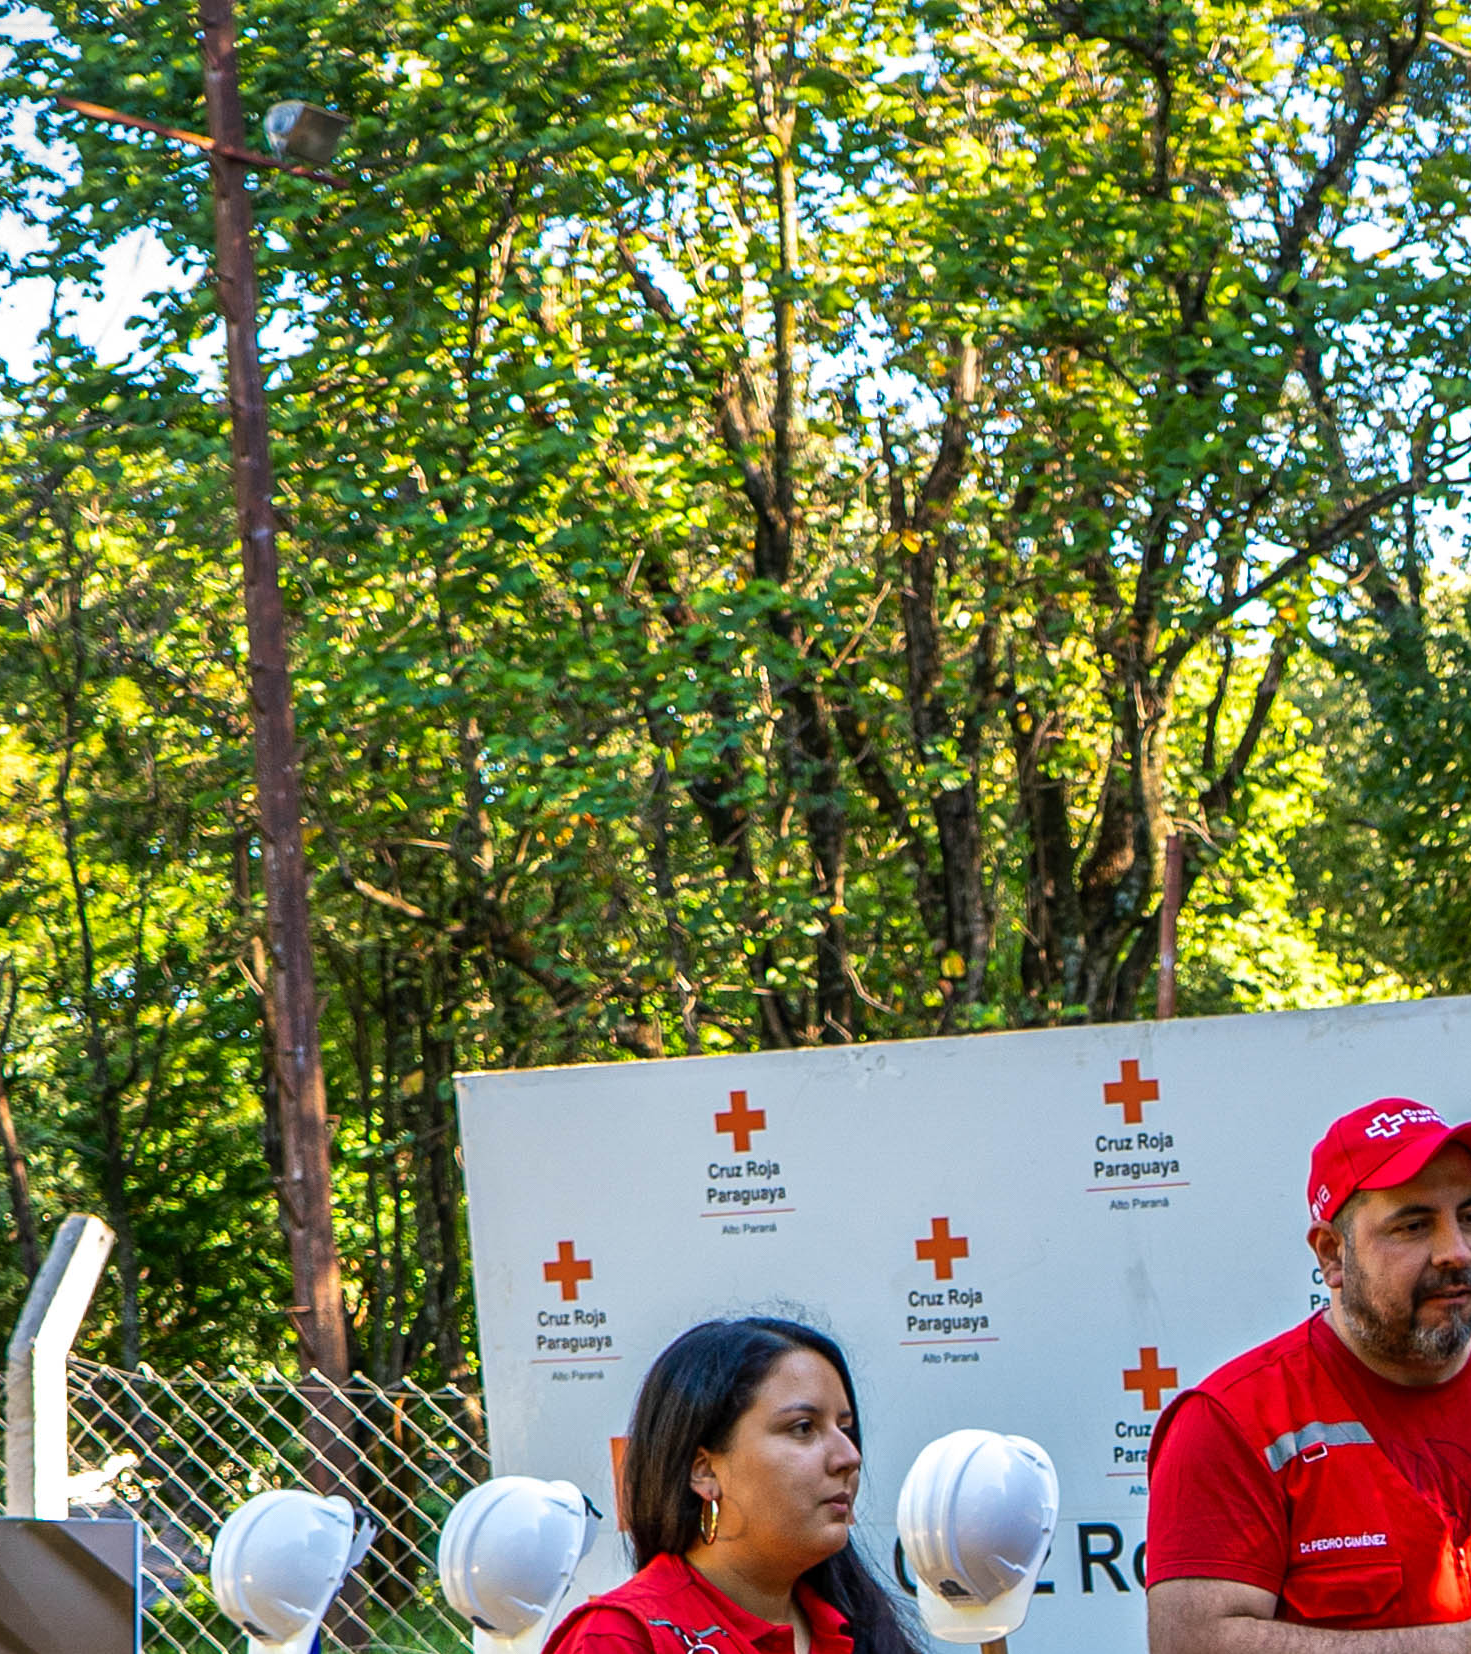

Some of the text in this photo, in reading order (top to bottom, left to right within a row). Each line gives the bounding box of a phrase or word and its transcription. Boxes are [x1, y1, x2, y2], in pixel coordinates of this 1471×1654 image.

[1095, 1132, 1173, 1152] Cruz Roja
[708, 1160, 780, 1180] Cruz Roja
[1094, 1160, 1179, 1179] Paraguaya
[707, 1187, 786, 1206] Paraguaya
[1110, 1199, 1129, 1210] Alto
[908, 1288, 983, 1308] Cruz Roja
[537, 1309, 607, 1328] Cruz Roja
[907, 1315, 989, 1334] Paraguaya
[536, 1335, 612, 1353] Paraguaya
[1115, 1421, 1152, 1438] Cruz
[1311, 1537, 1343, 1551] PEDRO
